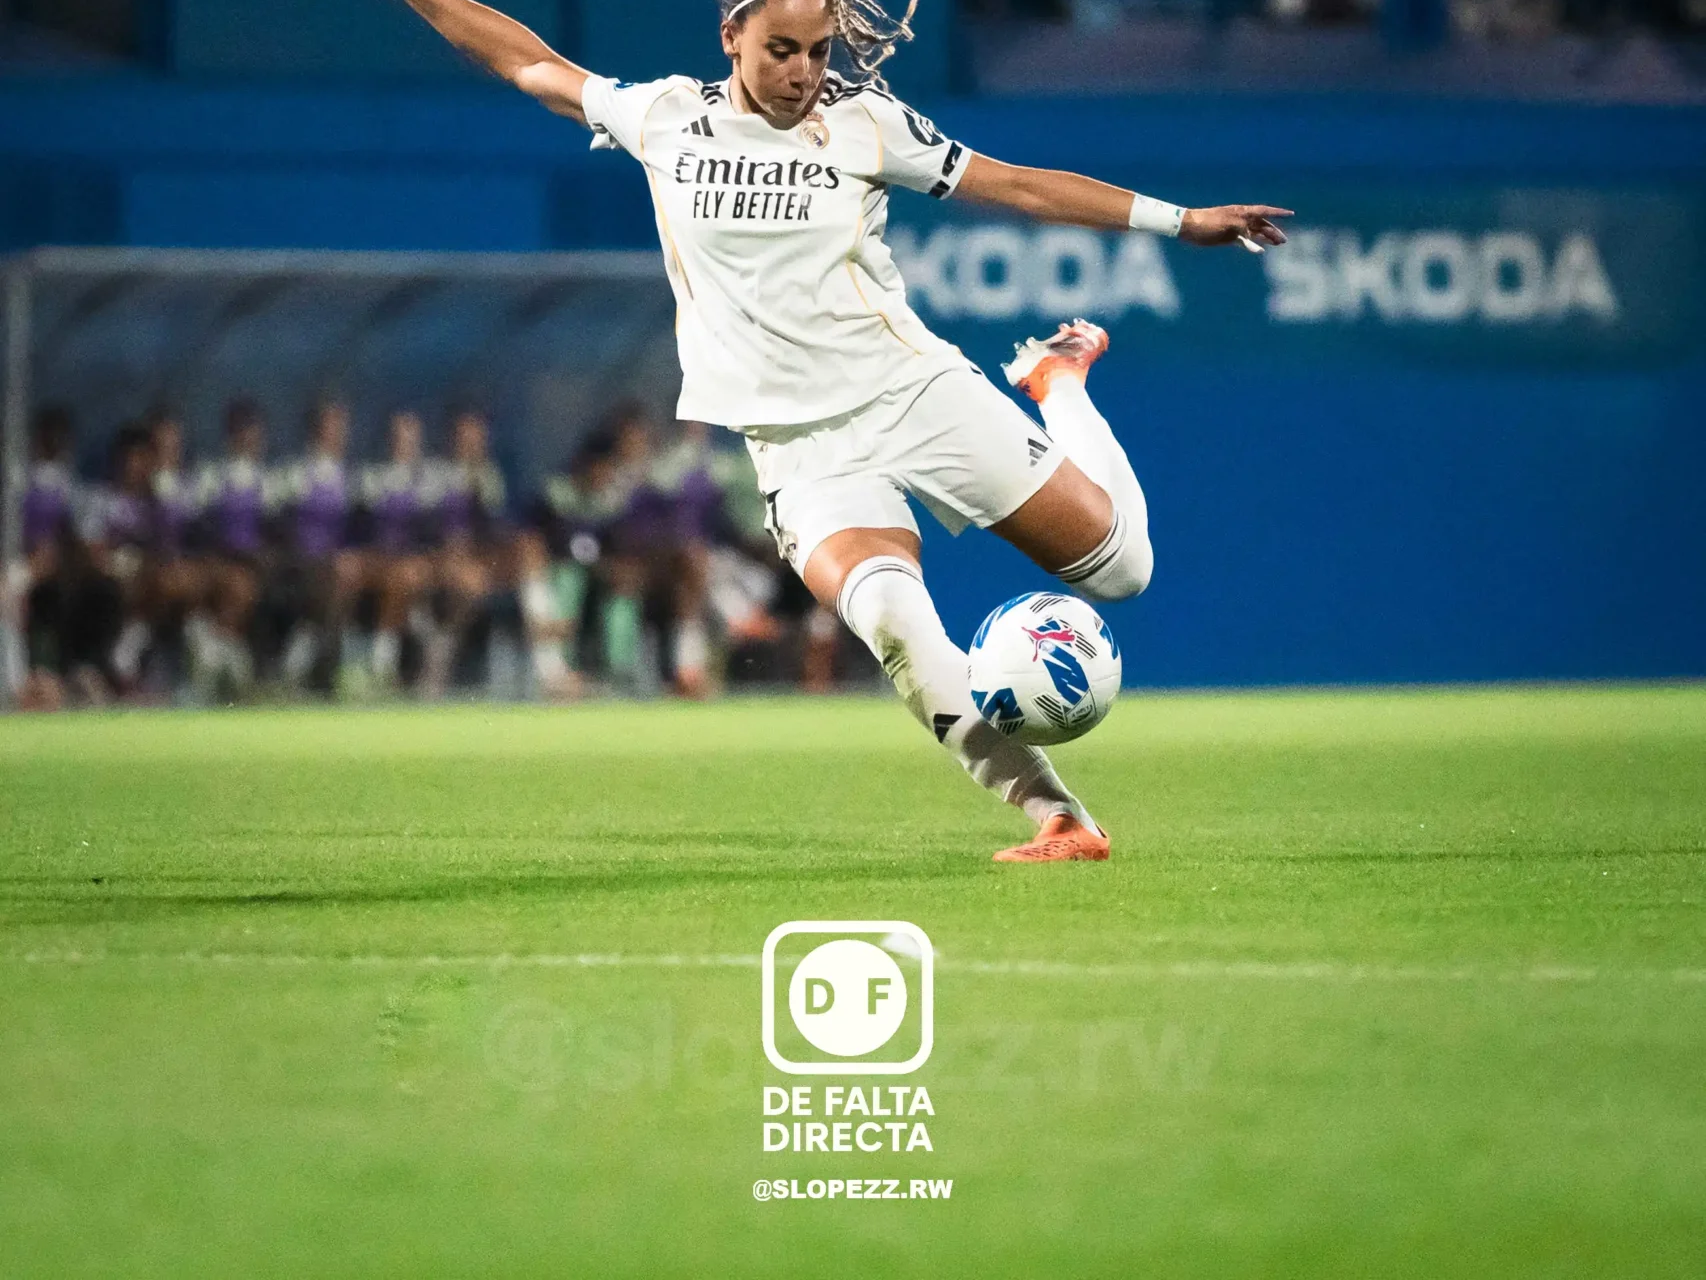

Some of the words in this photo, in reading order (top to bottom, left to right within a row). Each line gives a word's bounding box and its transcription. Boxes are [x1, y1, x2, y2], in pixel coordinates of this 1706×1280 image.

[675, 151, 841, 190] Emirates
[693, 190, 725, 219] FLY
[732, 191, 812, 221] BETTER
[885, 224, 1180, 320] KODA
